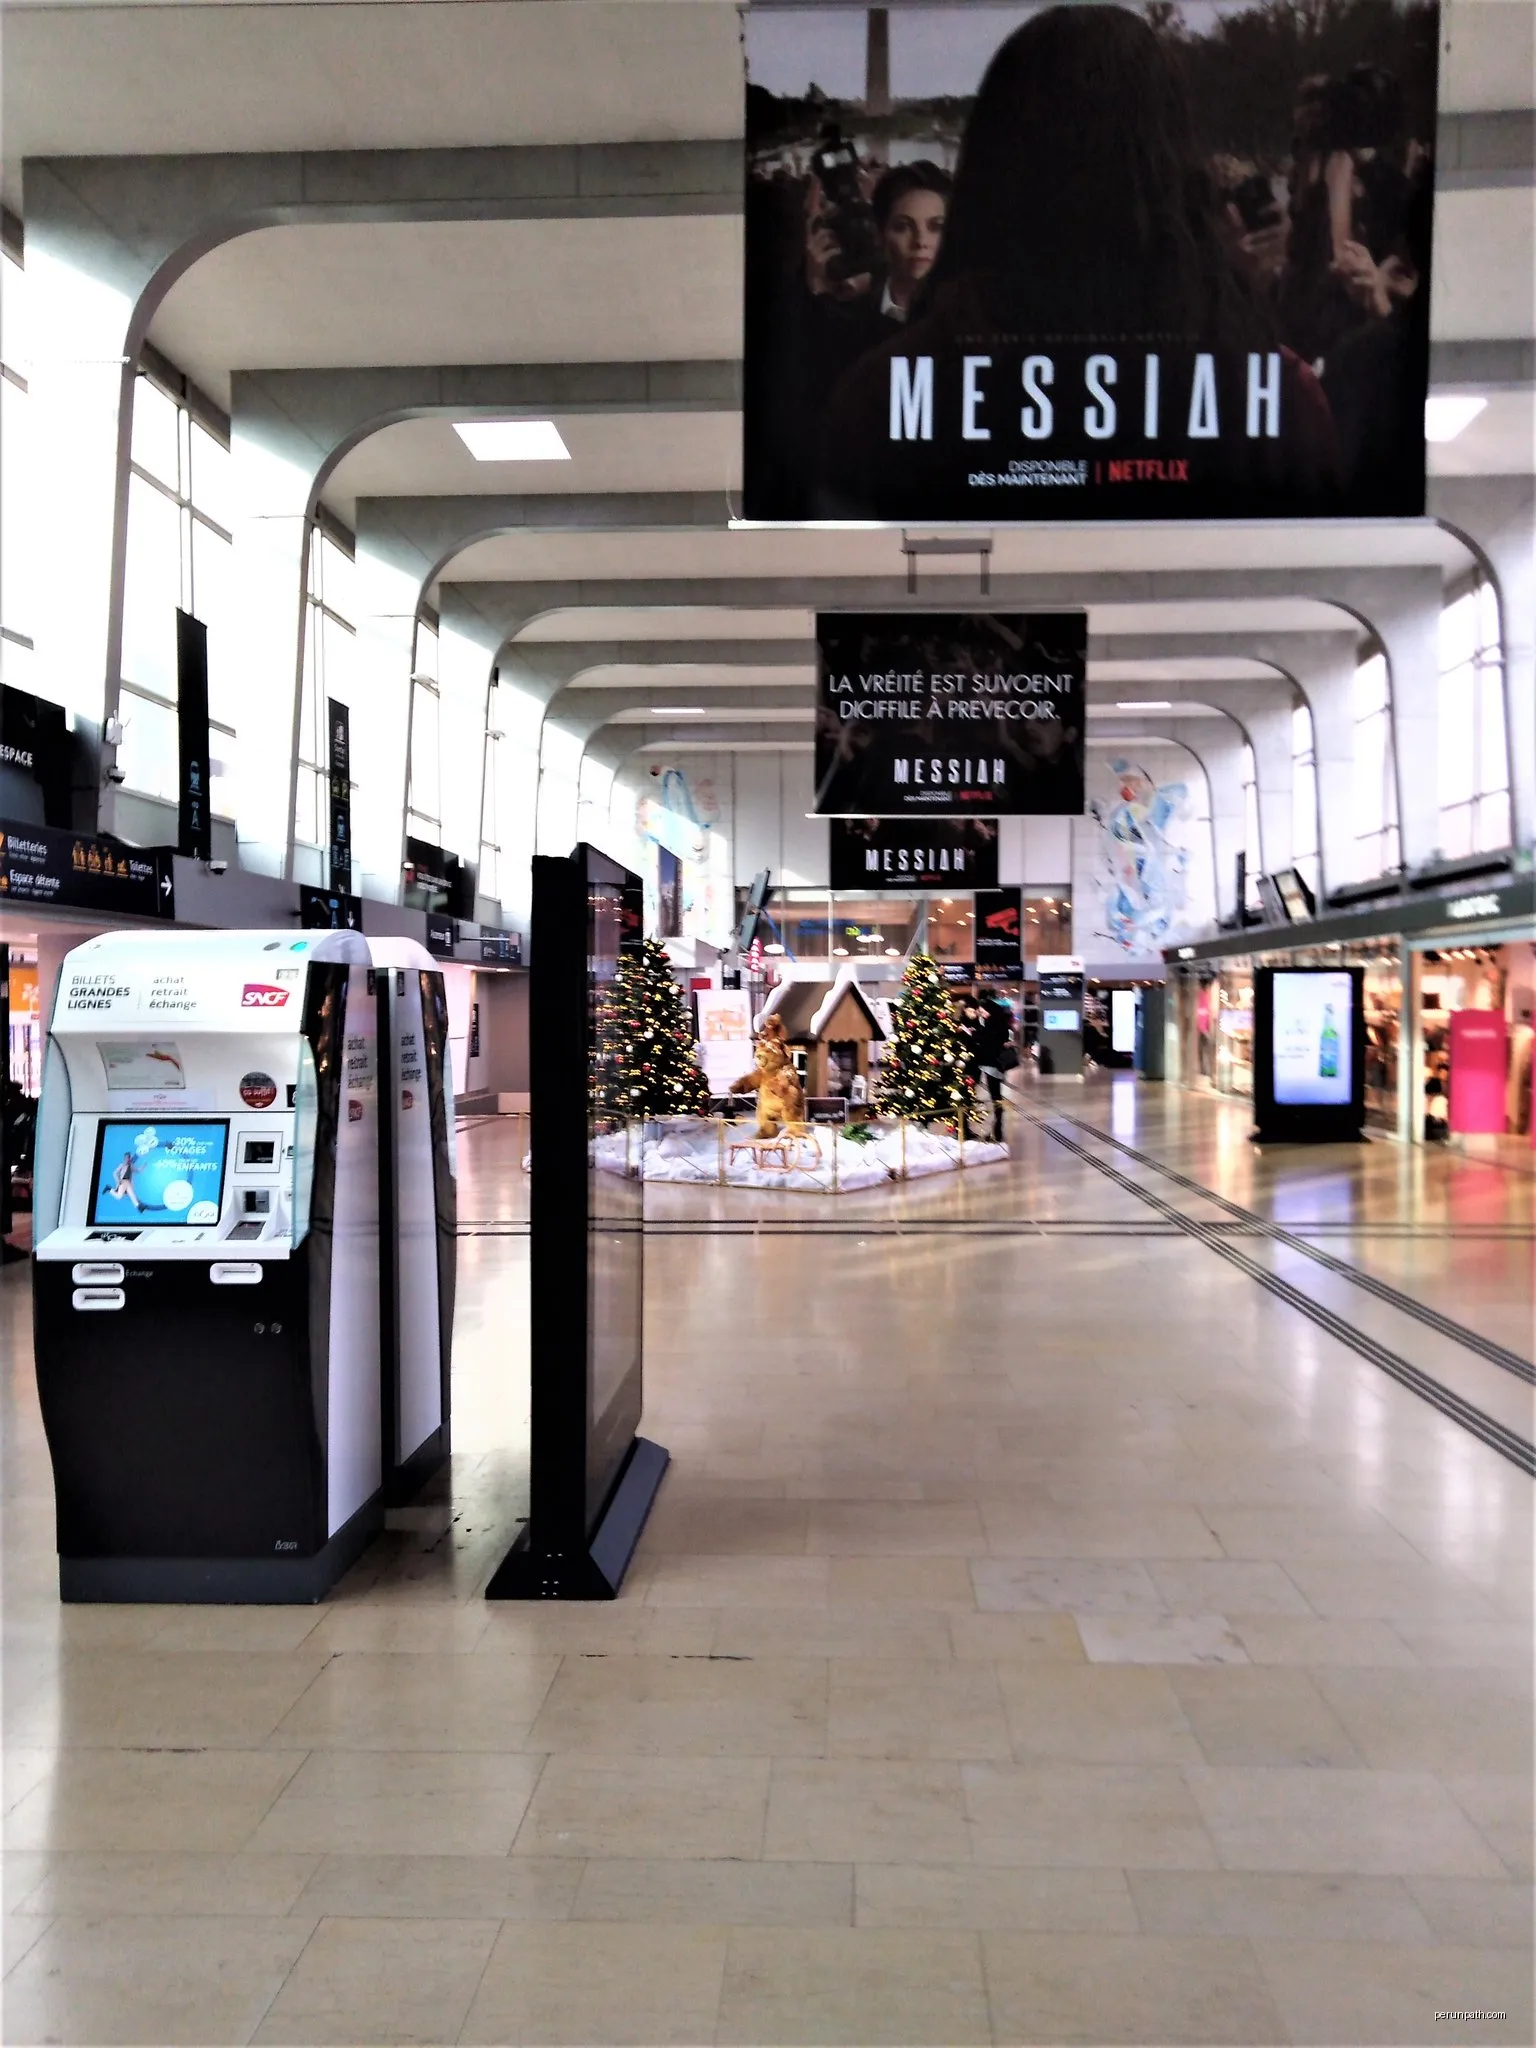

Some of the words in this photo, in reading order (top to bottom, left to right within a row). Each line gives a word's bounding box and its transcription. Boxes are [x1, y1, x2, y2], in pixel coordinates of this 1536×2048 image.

[889, 352, 1281, 440] MESSIAH
[1008, 460, 1088, 473] DISPONIBLE
[1108, 459, 1188, 481] NETFLIX
[968, 471, 996, 485] DÈS
[998, 473, 1088, 486] MAINTENANT
[829, 674, 854, 694] LA
[859, 669, 924, 694] VRÉITÉ
[931, 674, 966, 694] EST
[972, 674, 1074, 694] SUVOENT
[840, 700, 922, 719] DICIFFILE
[926, 696, 943, 719] À
[948, 700, 1061, 720] PREVECOIR.
[893, 758, 1006, 784] MESSIAH
[7, 836, 47, 855] Billetteries
[865, 849, 965, 872] MESSIAH
[10, 869, 34, 886] Espace
[35, 873, 60, 890] détente
[71, 974, 116, 985] BILLETS
[153, 975, 184, 985] achat
[69, 987, 131, 997] GRANDES
[150, 987, 188, 997] retrait
[243, 989, 290, 1005] SNCF
[67, 999, 112, 1010] LIGNES
[149, 998, 197, 1011] échange
[165, 1146, 207, 1155] VOYAGES
[176, 1162, 218, 1172] ENFANTS
